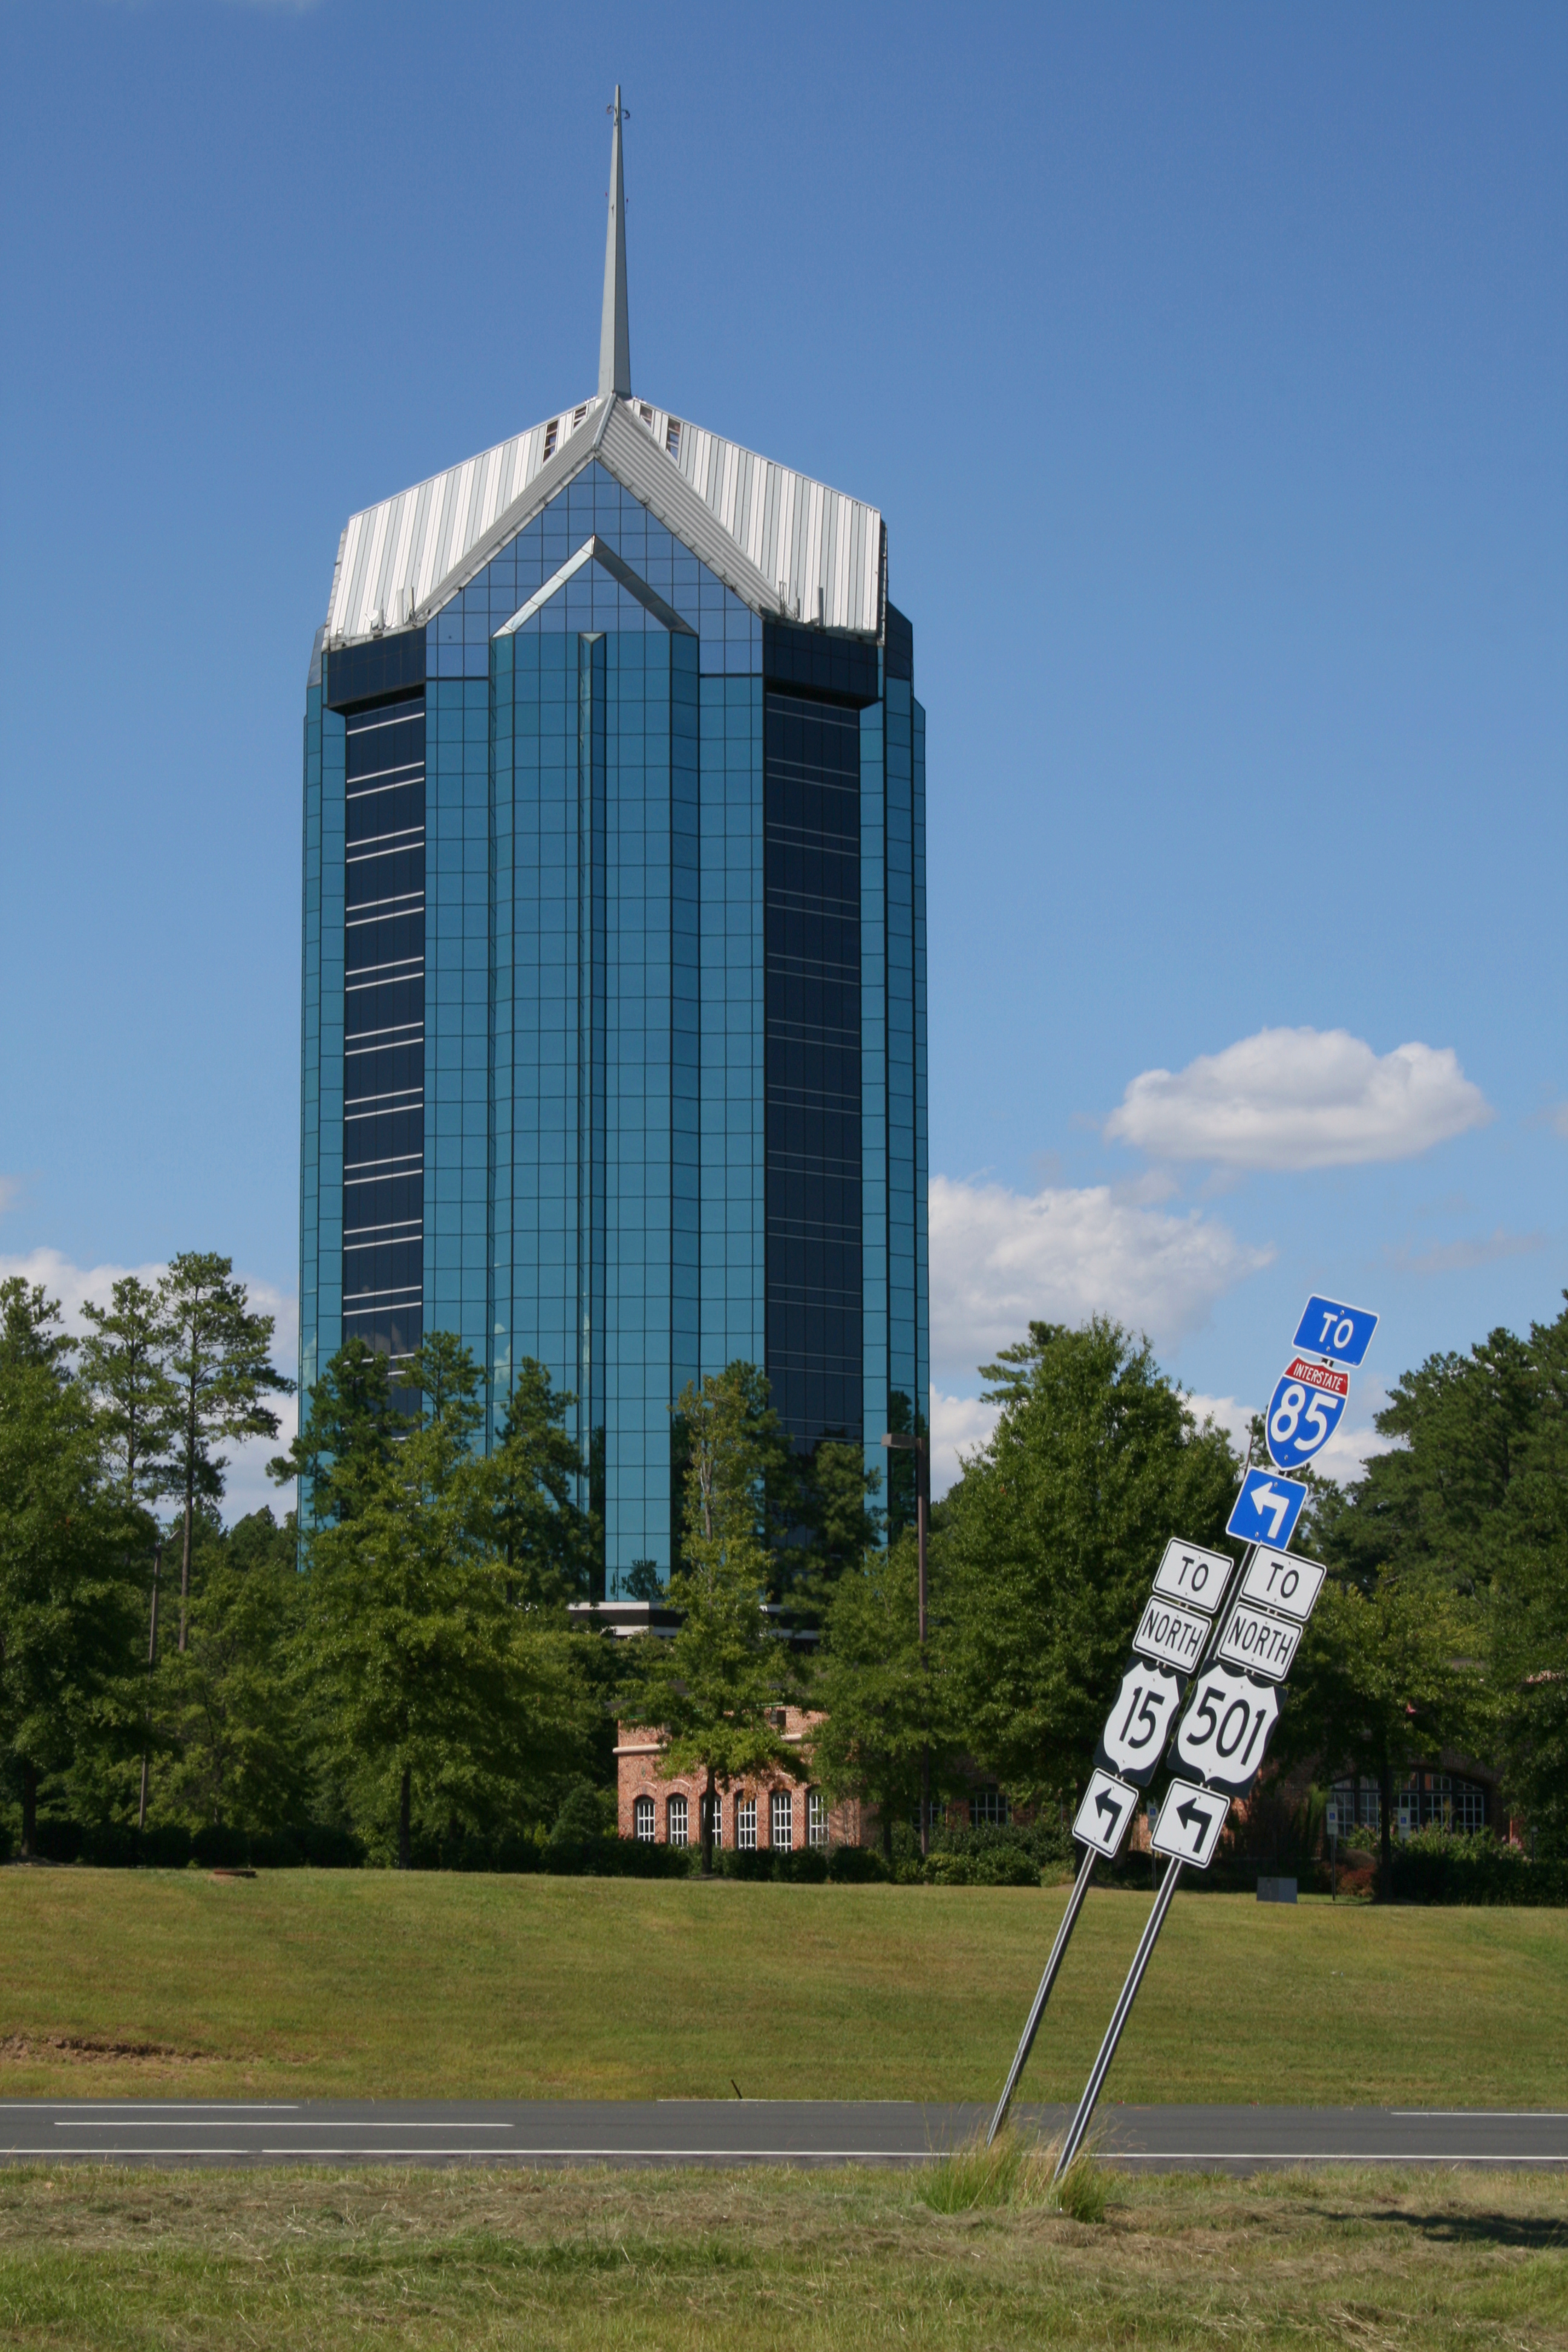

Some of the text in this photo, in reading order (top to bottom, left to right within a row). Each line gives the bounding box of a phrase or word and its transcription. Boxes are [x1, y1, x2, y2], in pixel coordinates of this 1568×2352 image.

[1319, 1312, 1353, 1348] TO
[1294, 1363, 1343, 1391] INTERSTATE
[1271, 1384, 1338, 1451] 85
[1178, 1557, 1209, 1592] TO
[1267, 1562, 1299, 1598] TO
[1142, 1609, 1203, 1658] NORTH
[1227, 1616, 1293, 1665] NORTH
[1119, 1687, 1165, 1748] 15
[1186, 1687, 1267, 1766] 501
